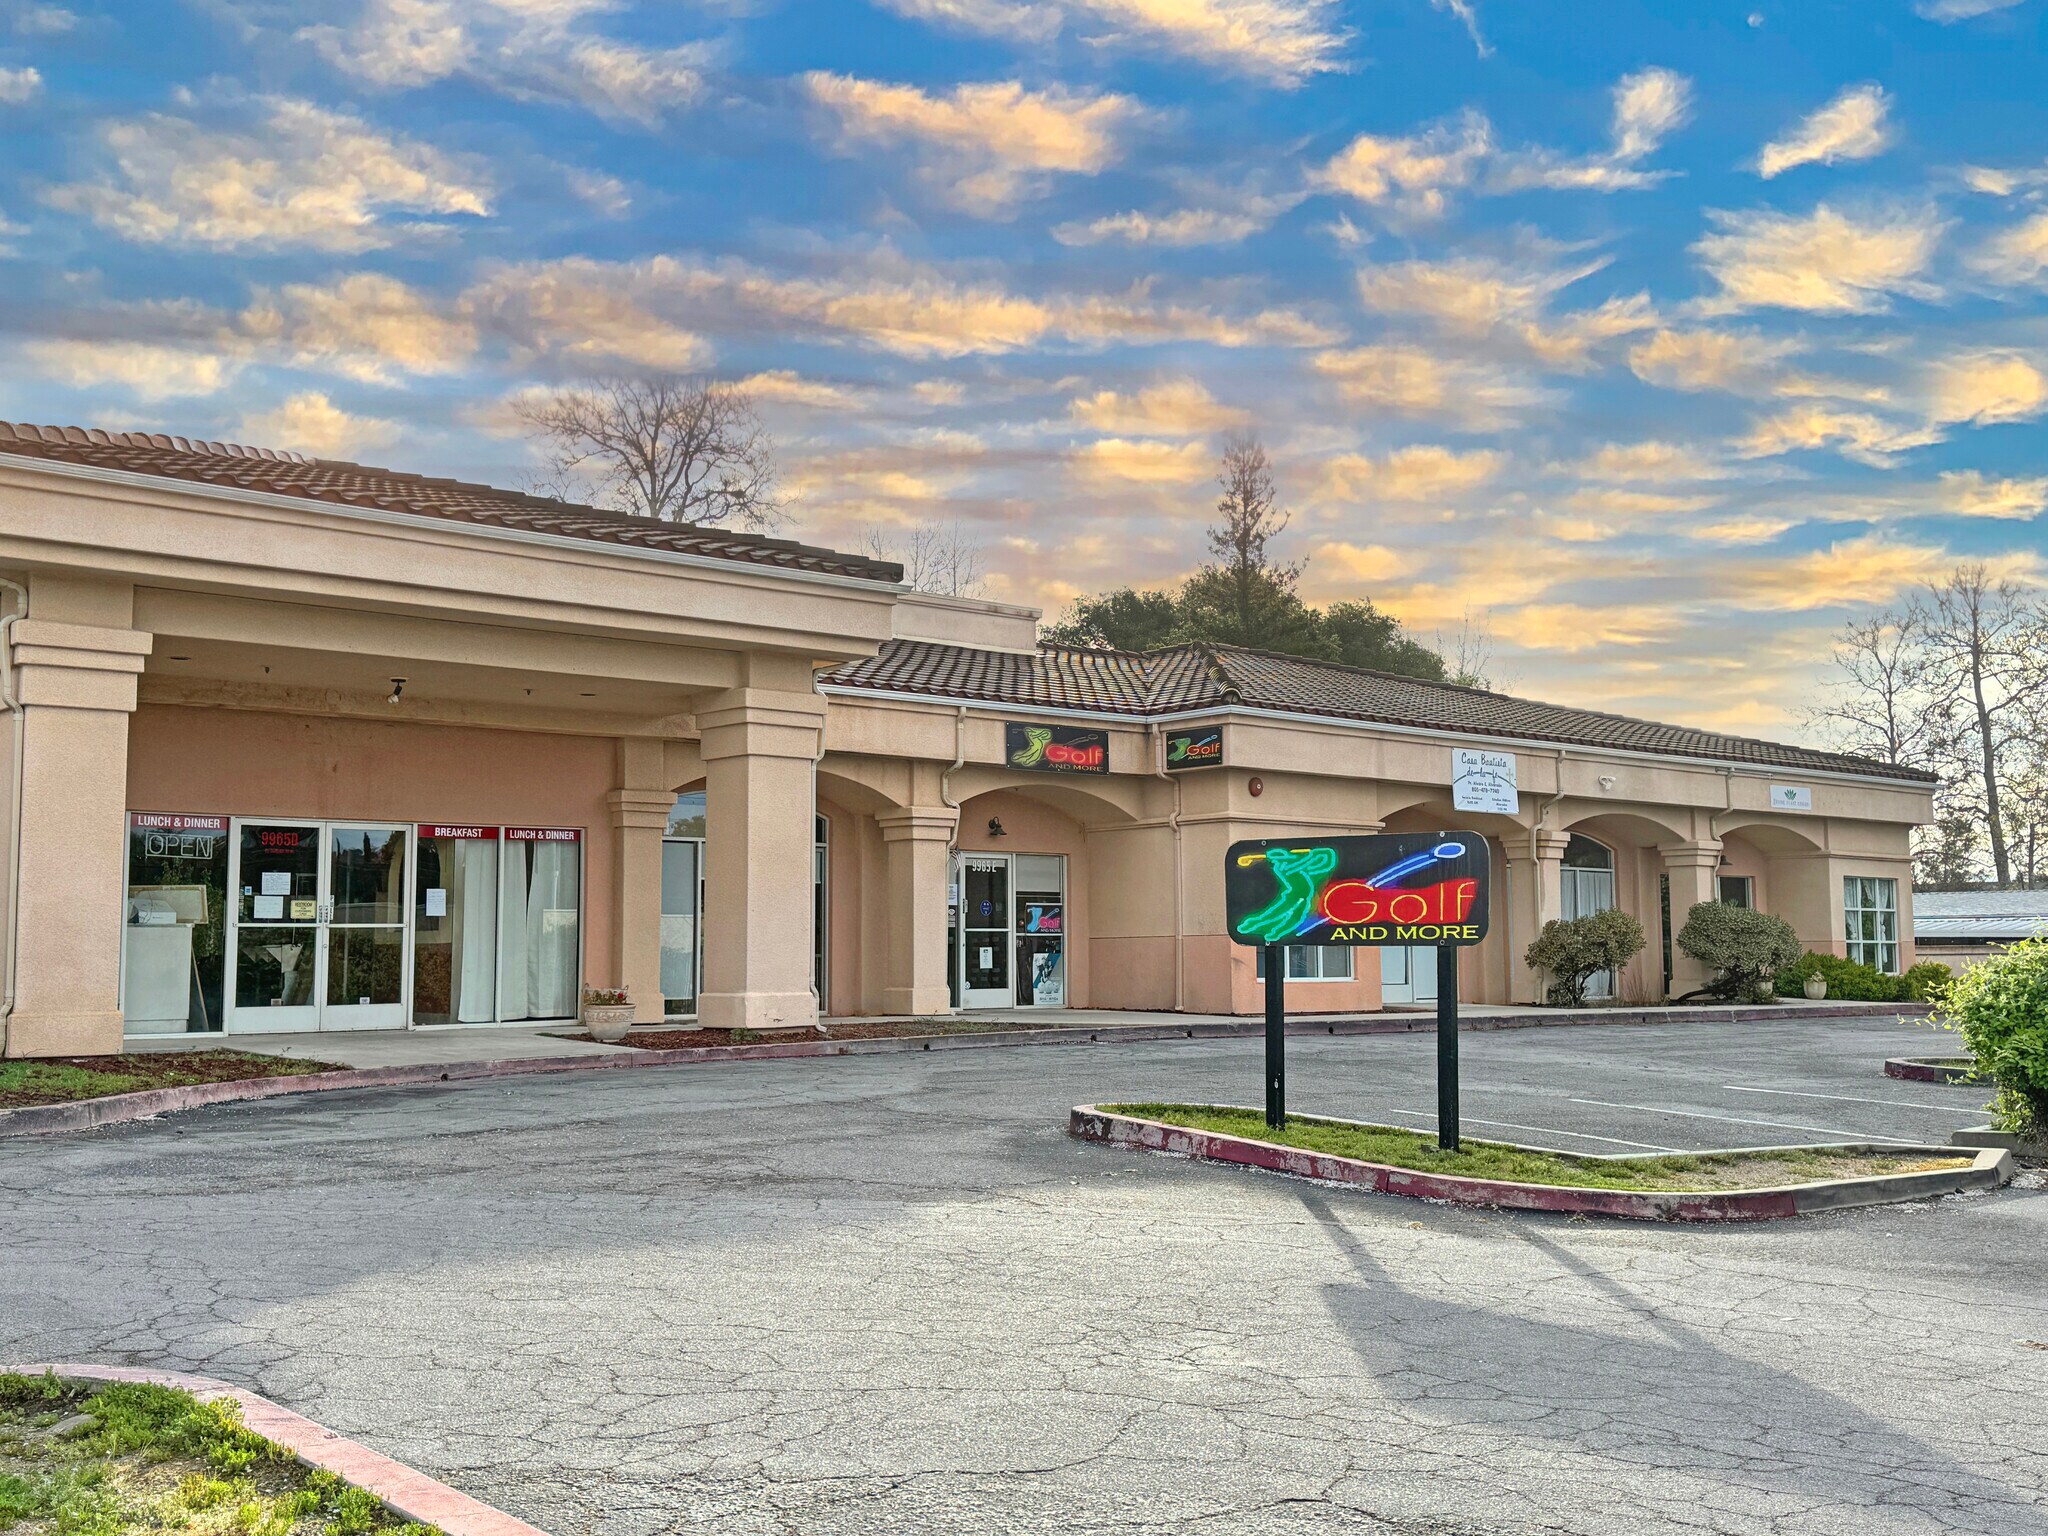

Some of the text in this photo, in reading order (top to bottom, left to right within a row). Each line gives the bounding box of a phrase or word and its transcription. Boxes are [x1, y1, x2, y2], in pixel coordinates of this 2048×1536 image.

[1046, 744, 1104, 764] Golf
[1187, 743, 1220, 755] Golf
[1461, 752, 1507, 767] Casa Bautista
[1467, 766, 1474, 777] de
[1480, 767, 1486, 777] la
[138, 816, 220, 829] LUNCH & DINNER
[261, 831, 299, 847] 9965D
[435, 827, 483, 838] BREAKFAST
[510, 829, 575, 840] LUNCH & DINNER
[148, 834, 210, 857] OPEN
[1324, 881, 1475, 924] Golf
[1039, 917, 1061, 928] Golf
[1330, 925, 1480, 941] AND MORE
